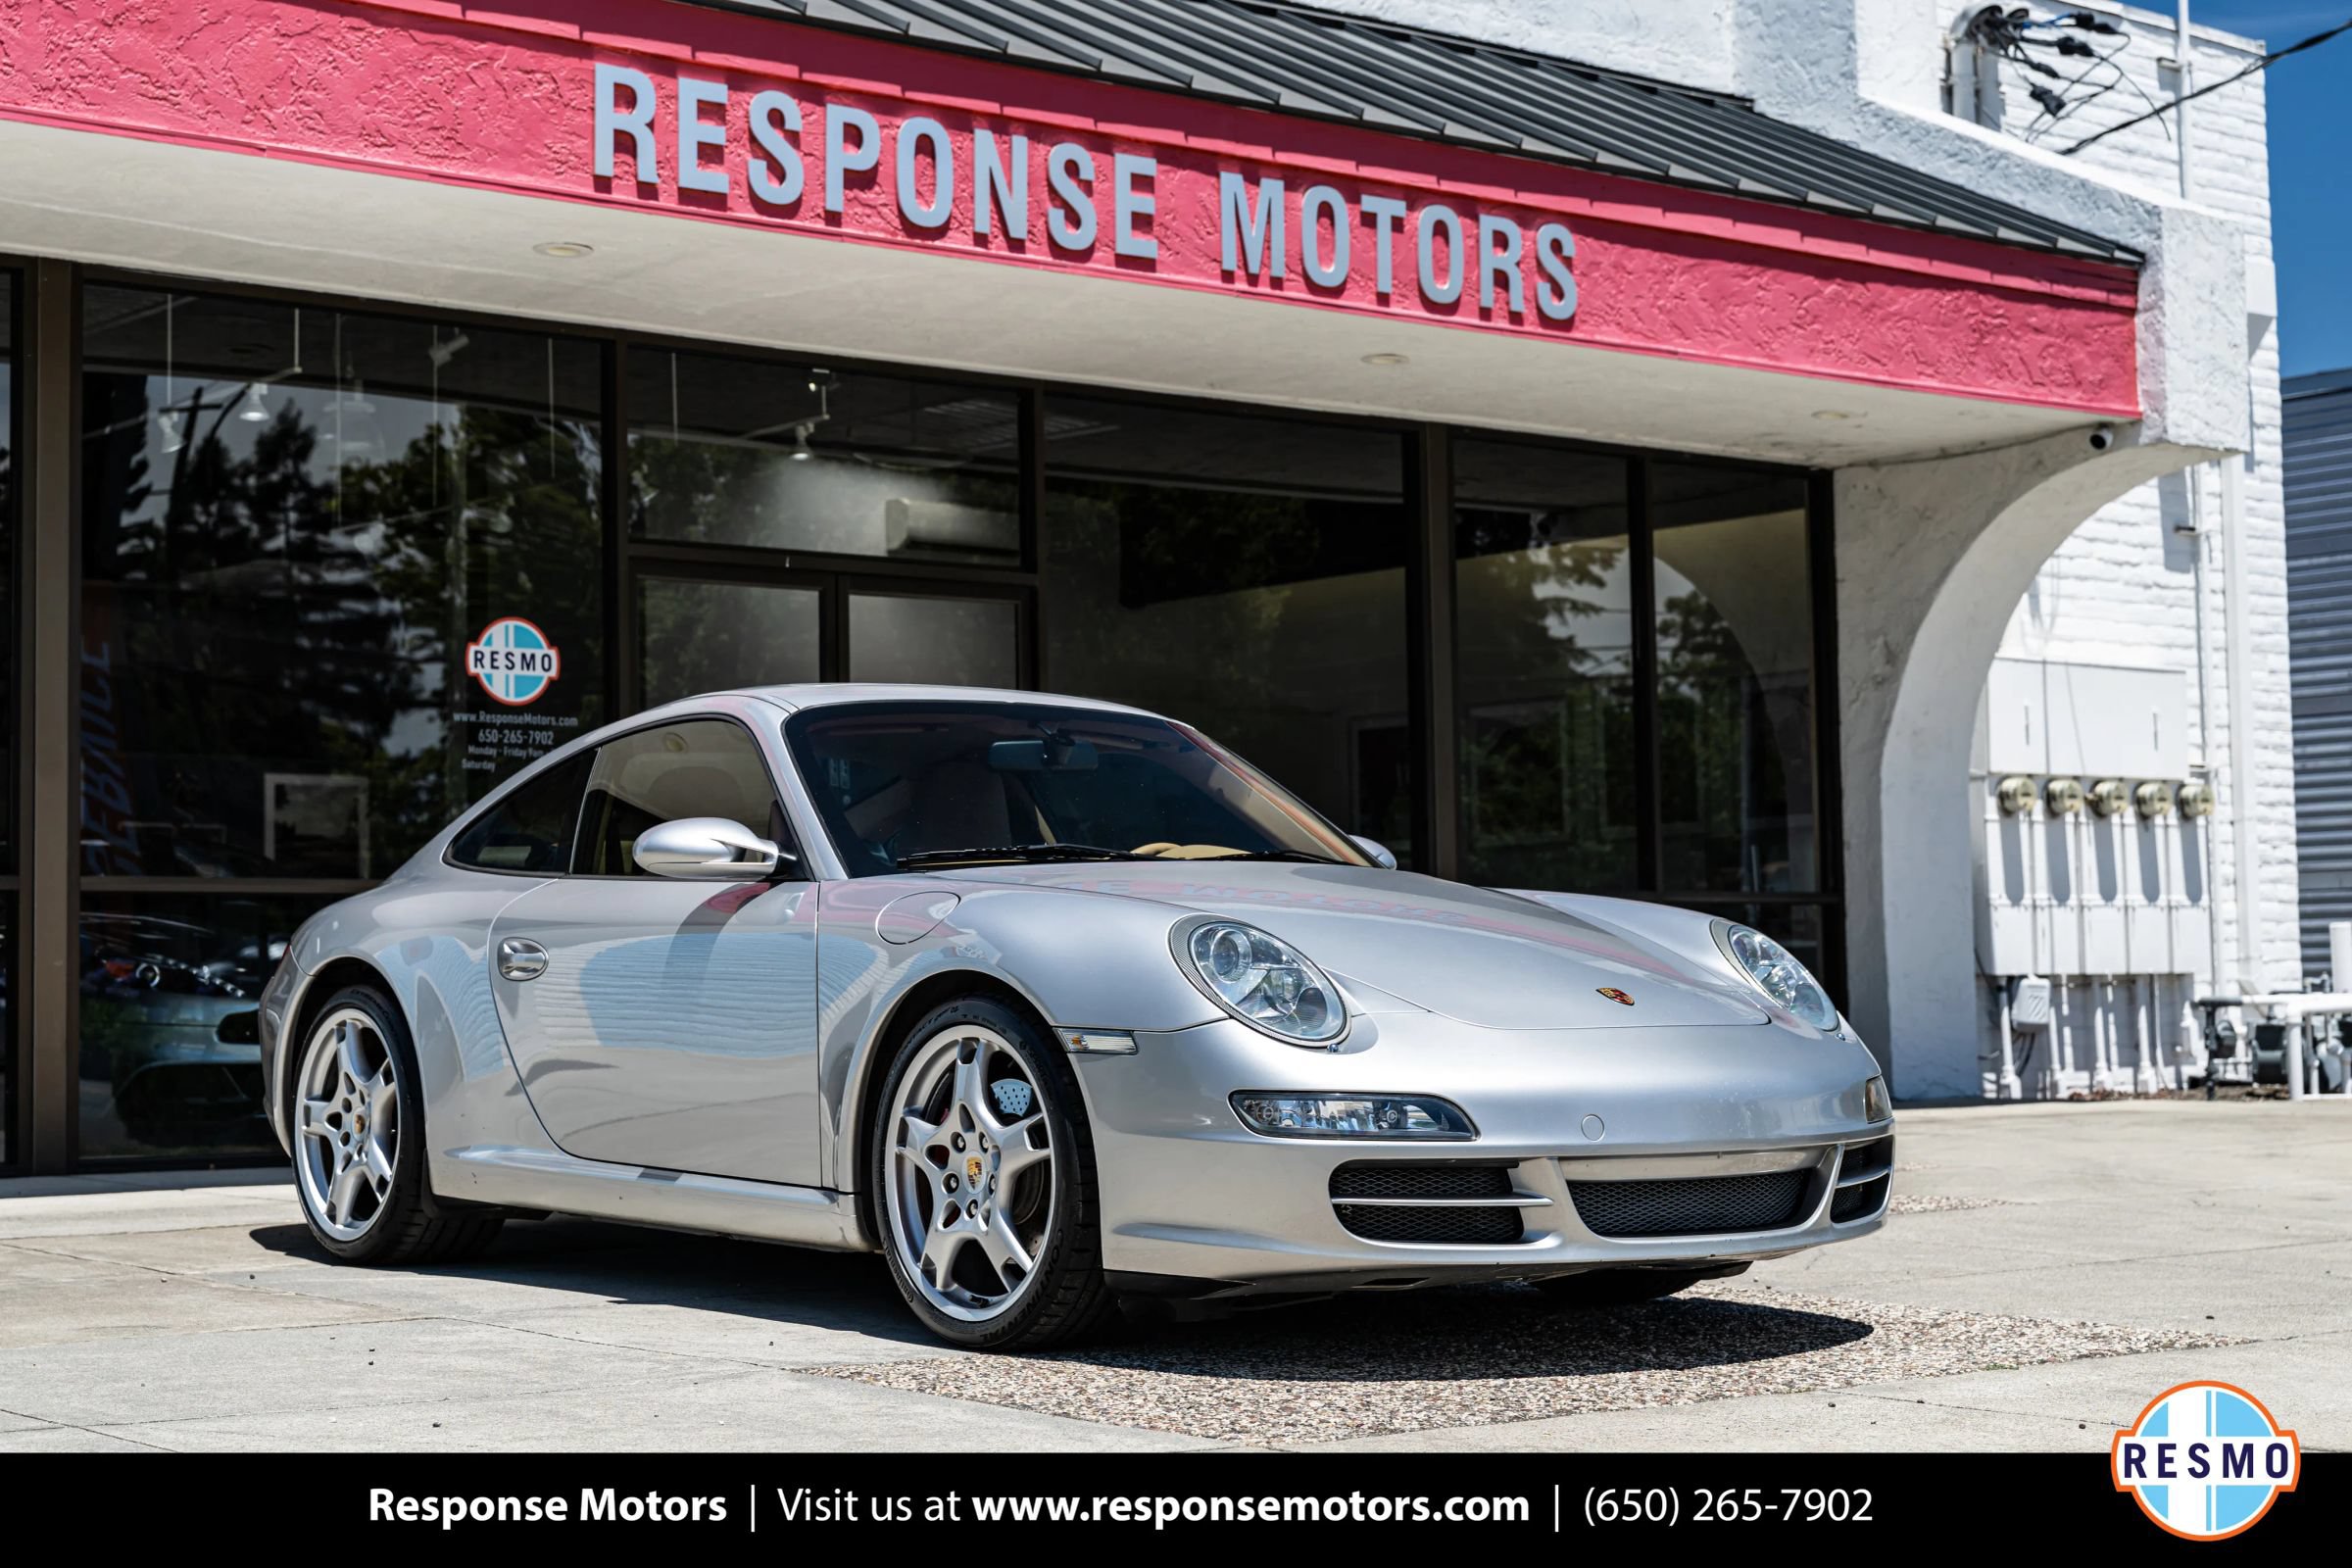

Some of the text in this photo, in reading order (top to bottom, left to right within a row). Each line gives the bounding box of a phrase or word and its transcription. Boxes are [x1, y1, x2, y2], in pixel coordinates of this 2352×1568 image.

[594, 62, 1578, 320] RESPONSE MOTORS
[473, 650, 552, 673] RESMO
[453, 710, 578, 726] www.ResponseMotors.com
[478, 729, 555, 745] 650-265-7902
[467, 745, 497, 758] Monday
[503, 746, 527, 760] Friday
[462, 759, 496, 772] Saturday
